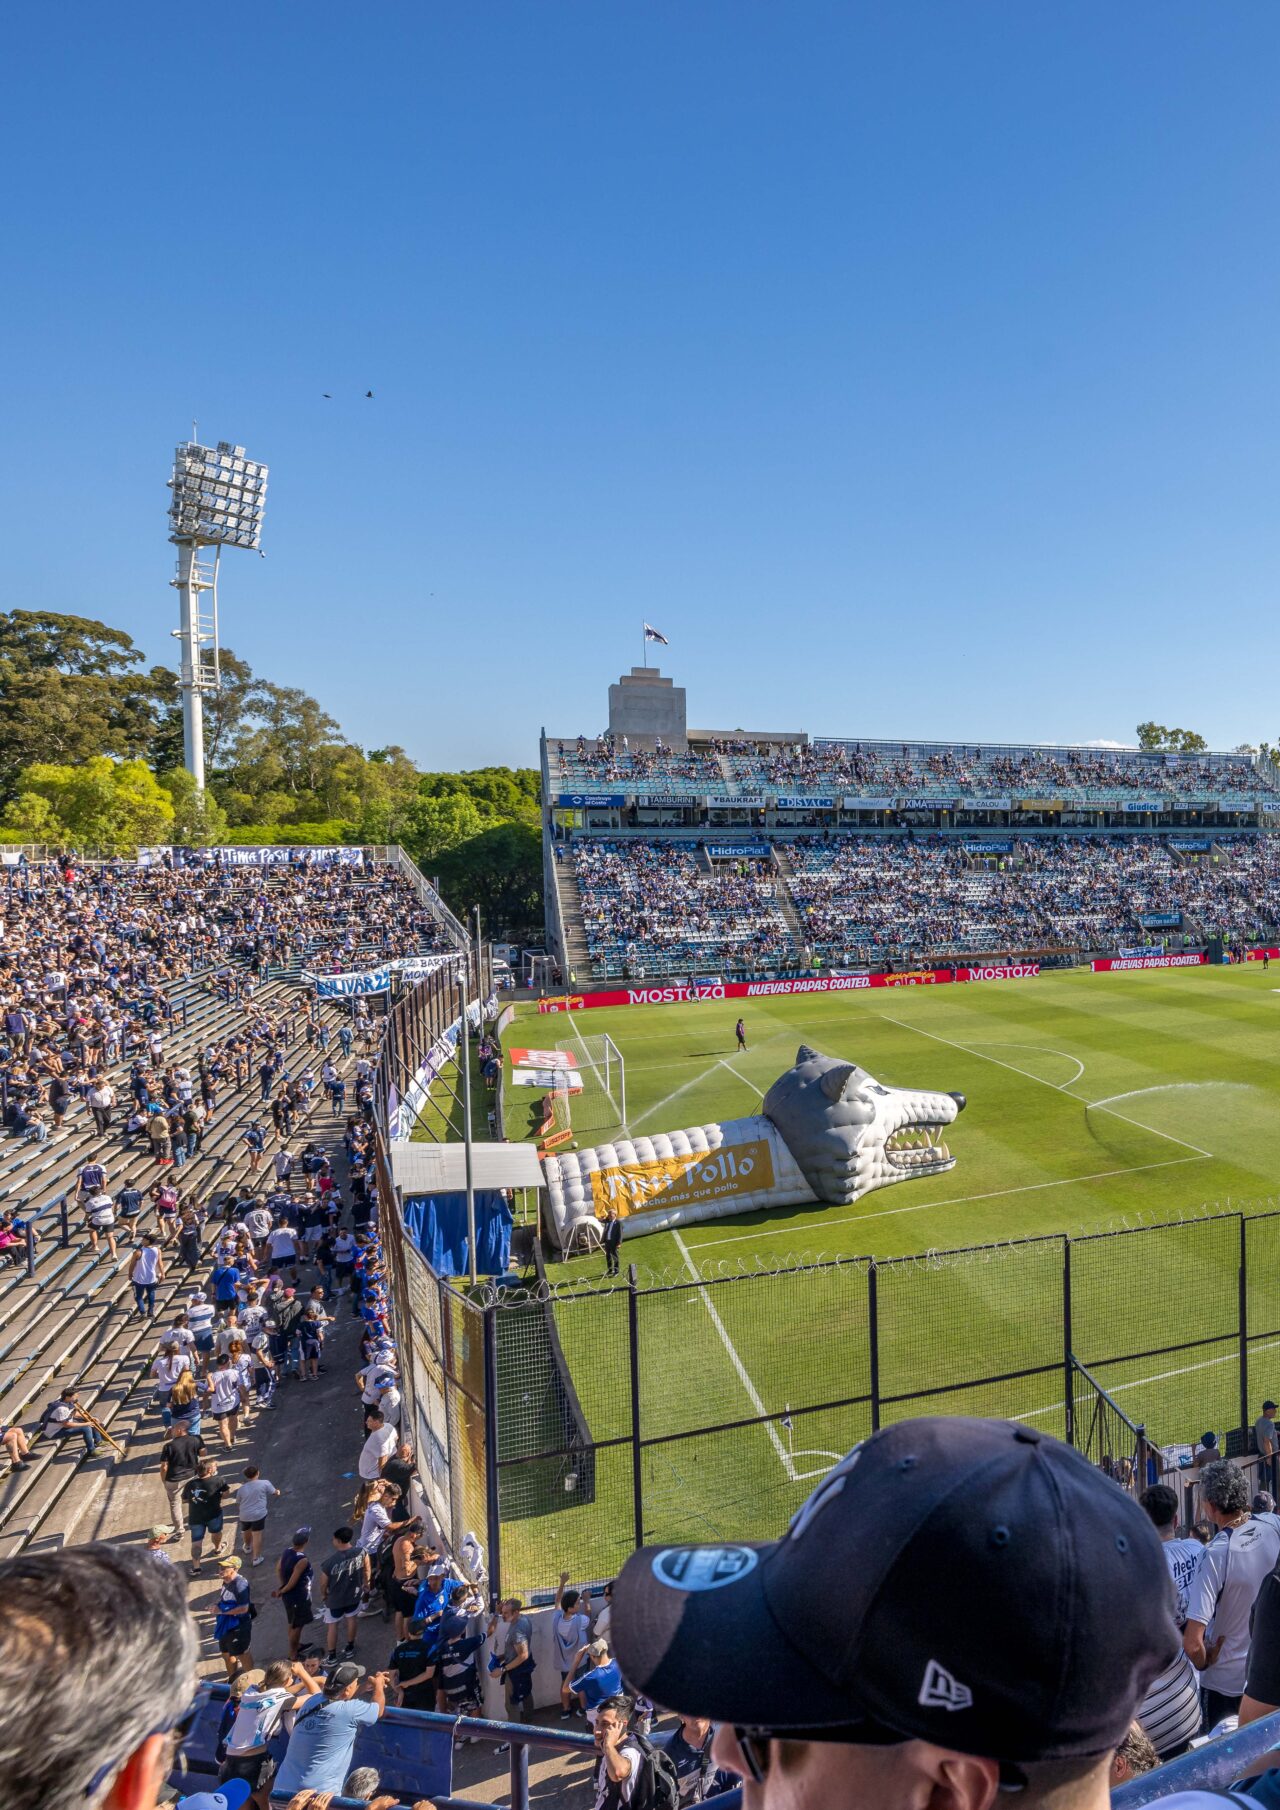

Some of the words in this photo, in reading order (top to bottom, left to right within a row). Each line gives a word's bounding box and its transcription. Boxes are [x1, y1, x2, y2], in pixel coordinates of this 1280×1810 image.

[650, 796, 693, 804] TAMBURINI
[1127, 803, 1158, 811] Giudice
[711, 847, 765, 855] HidroPlat
[1171, 842, 1207, 850] HidroPlat
[1110, 957, 1142, 970] NUEVAS
[1142, 956, 1170, 968] PAPAS
[747, 983, 792, 996] NUEVAS
[792, 979, 829, 992] PAPAS
[683, 1151, 754, 1187] Pollo
[670, 1191, 690, 1201] más
[693, 1188, 711, 1198] que
[714, 1181, 739, 1195] pollo
